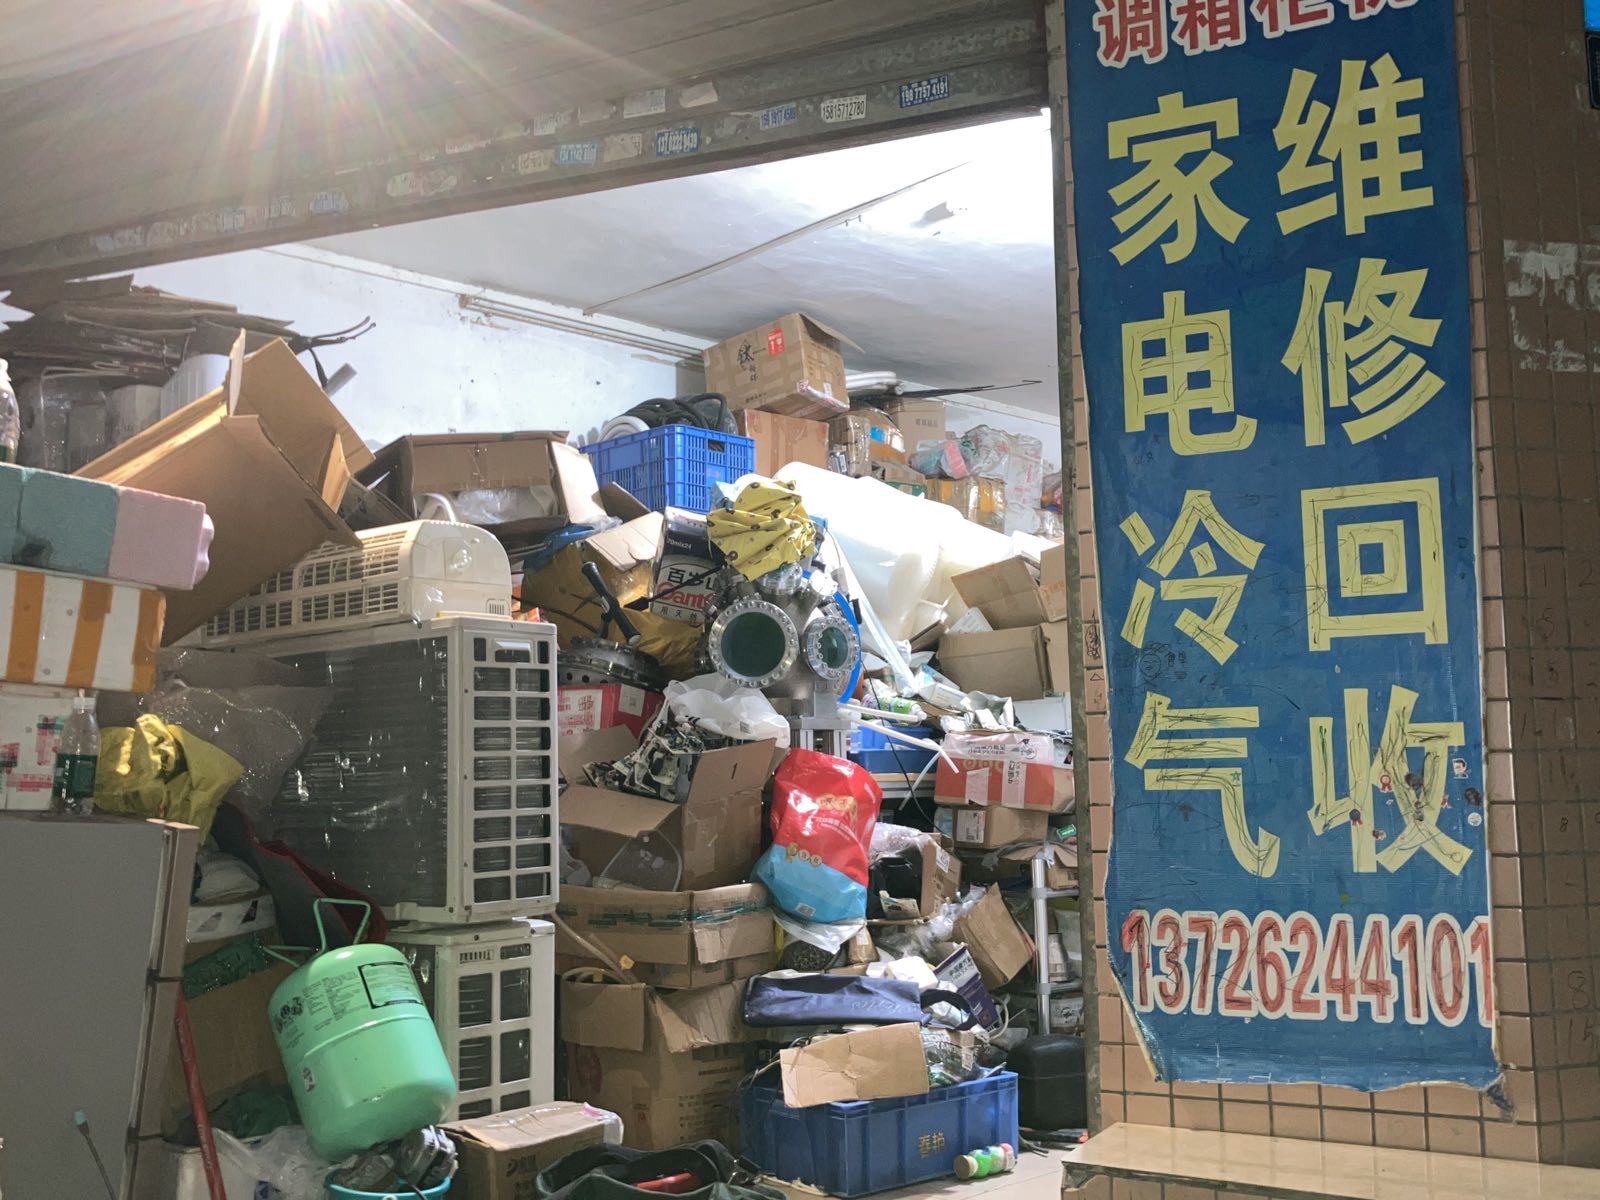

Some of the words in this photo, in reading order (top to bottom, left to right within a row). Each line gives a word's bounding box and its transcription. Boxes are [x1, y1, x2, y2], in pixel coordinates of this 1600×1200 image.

[1107, 91, 1281, 878] 家电冷气
[1272, 52, 1473, 876] 维修回收
[1119, 907, 1494, 1026] 13726244101
